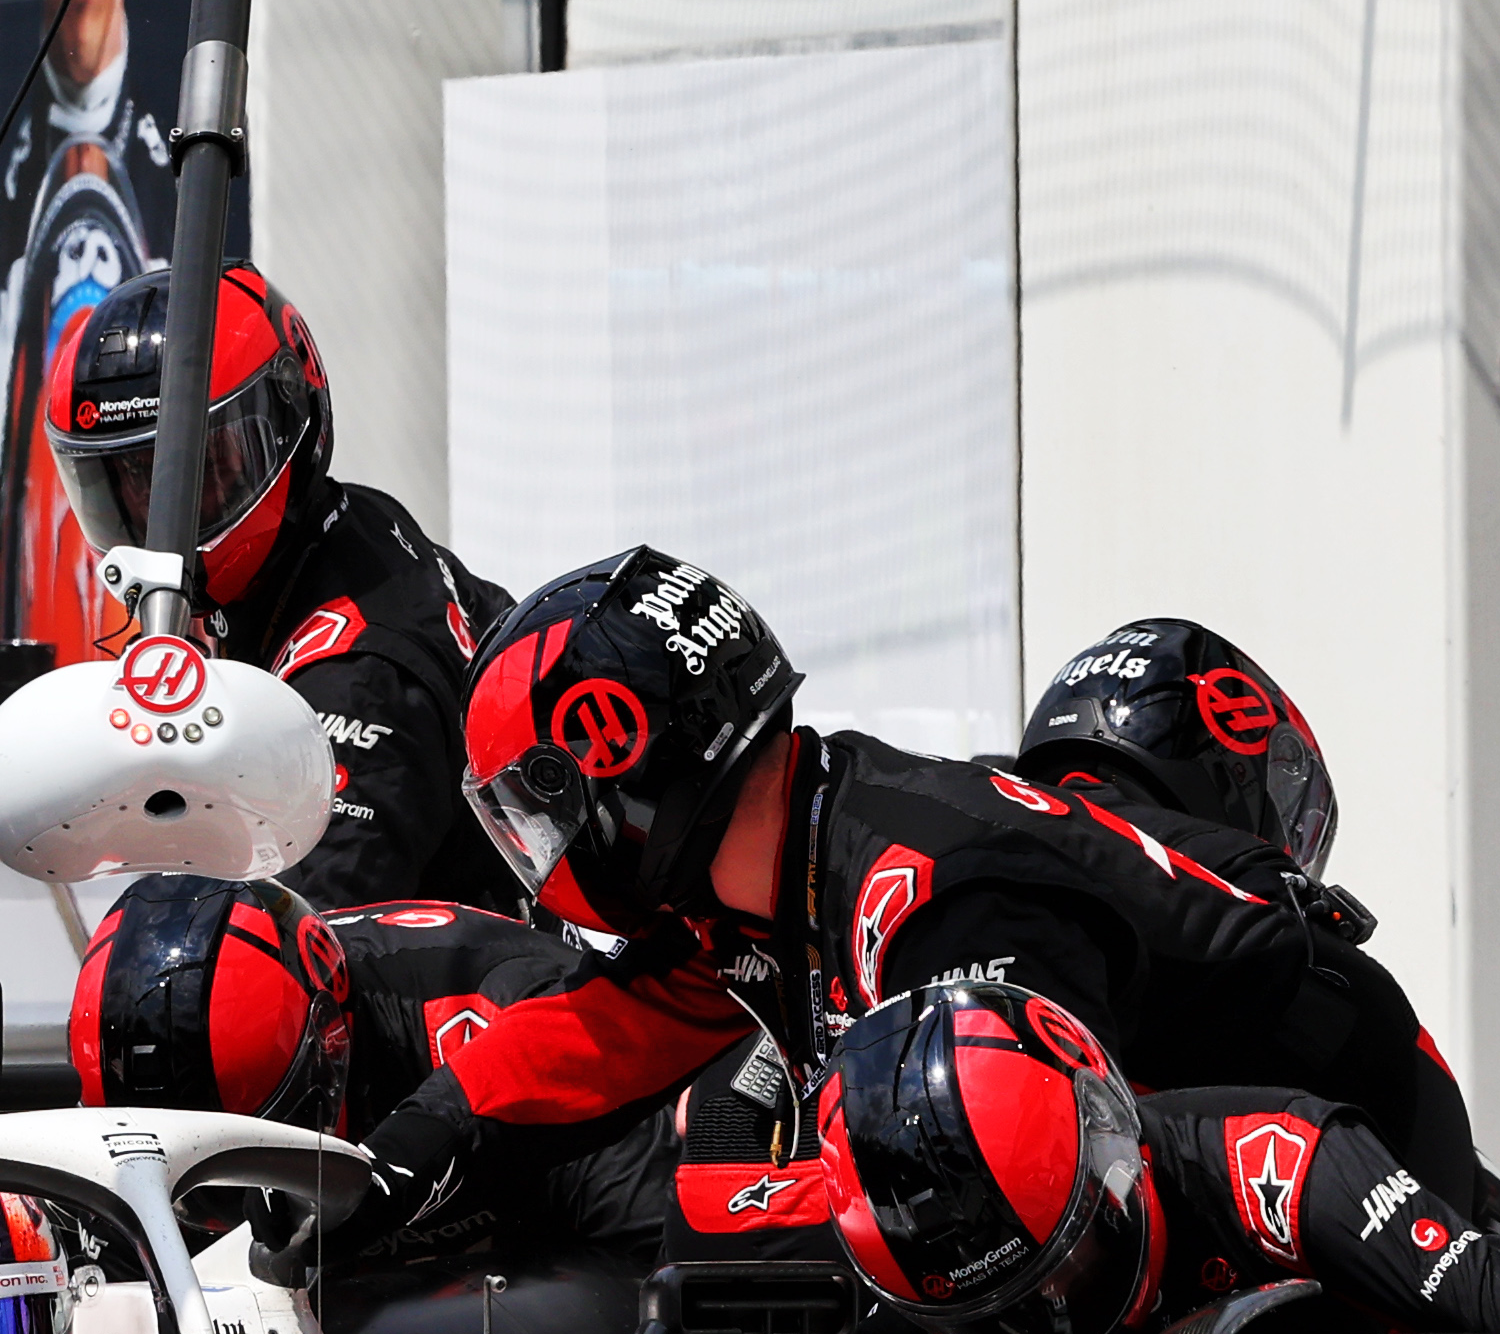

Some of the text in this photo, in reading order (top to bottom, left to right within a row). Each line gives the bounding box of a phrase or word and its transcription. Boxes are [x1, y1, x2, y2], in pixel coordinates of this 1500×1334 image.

[630, 563, 709, 631] Palm
[104, 1139, 162, 1149] TRICORP
[114, 1156, 168, 1168] WORKWEAR
[1360, 1169, 1422, 1242] HAAS
[25, 1273, 48, 1286] Inc.
[948, 1237, 1022, 1282] MoneyGram
[956, 1272, 987, 1290] HAAS
[998, 1246, 1030, 1268] TEAM
